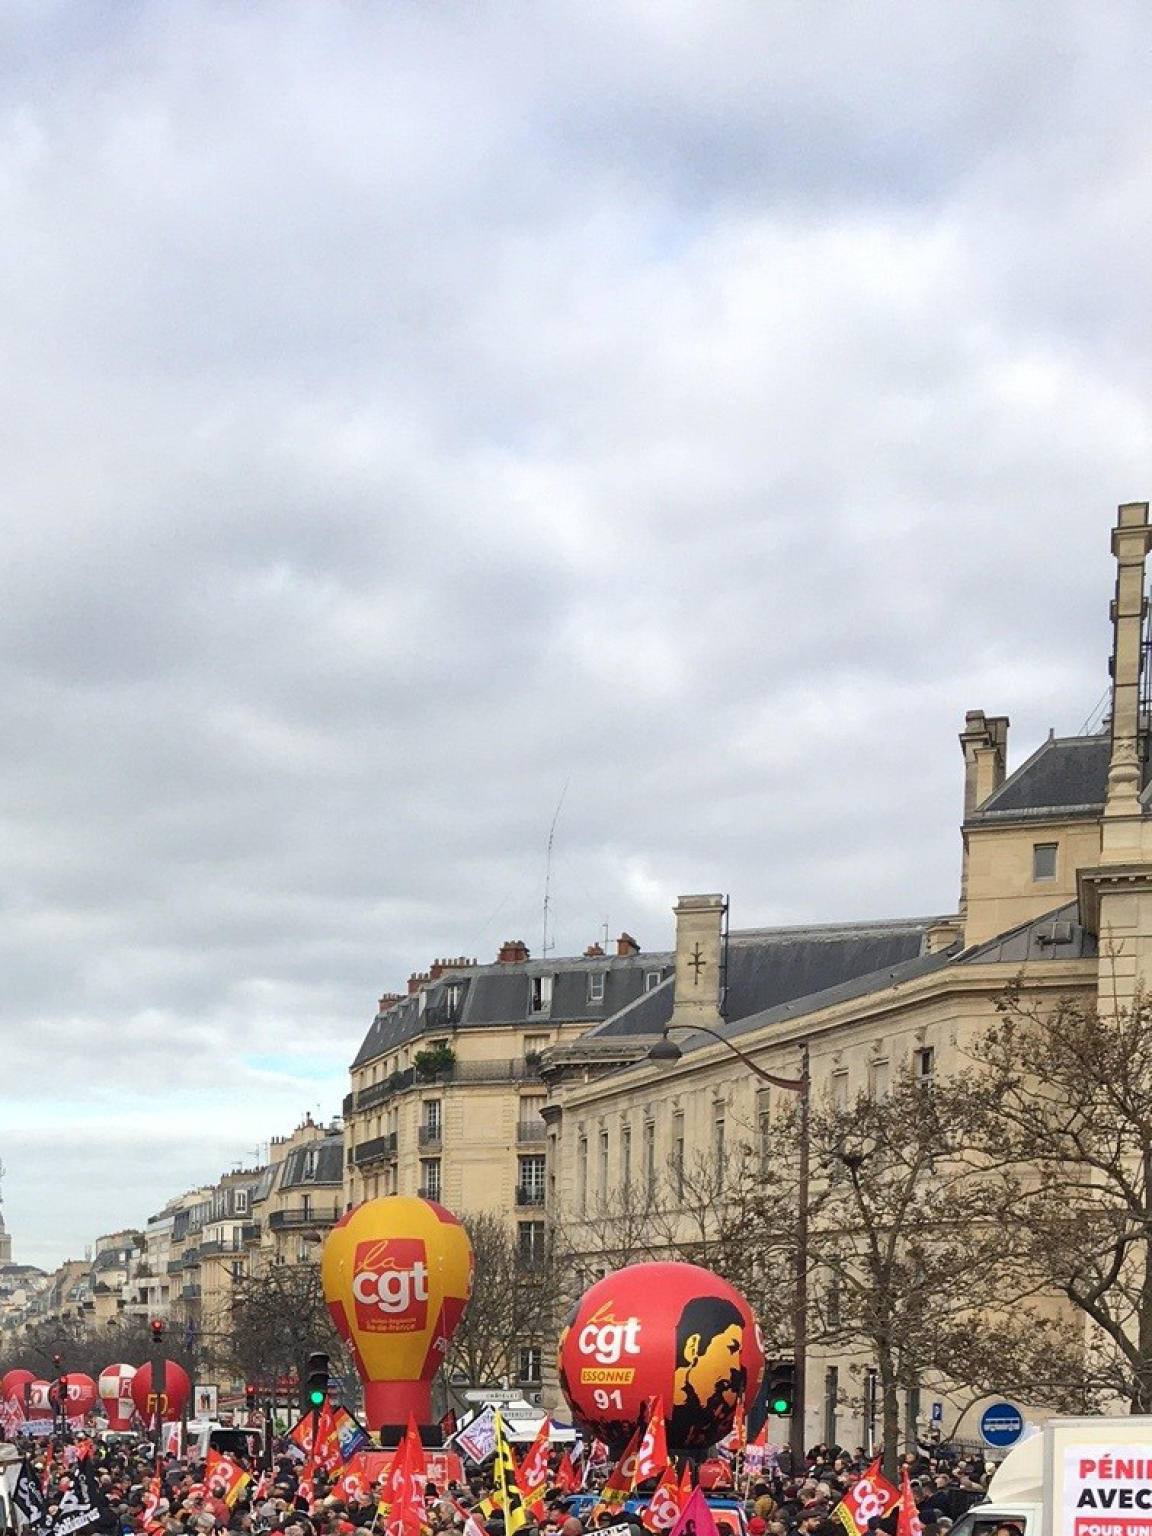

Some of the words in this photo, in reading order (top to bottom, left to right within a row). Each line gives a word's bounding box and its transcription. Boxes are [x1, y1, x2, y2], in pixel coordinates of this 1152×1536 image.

[353, 1261, 429, 1313] cgt
[579, 1317, 642, 1364] cgt
[582, 1370, 632, 1382] ESSONNE
[593, 1389, 622, 1410] 91
[1079, 1453, 1152, 1479] PÉNI
[1076, 1488, 1152, 1509] AVEC
[1078, 1524, 1122, 1536] POUR
